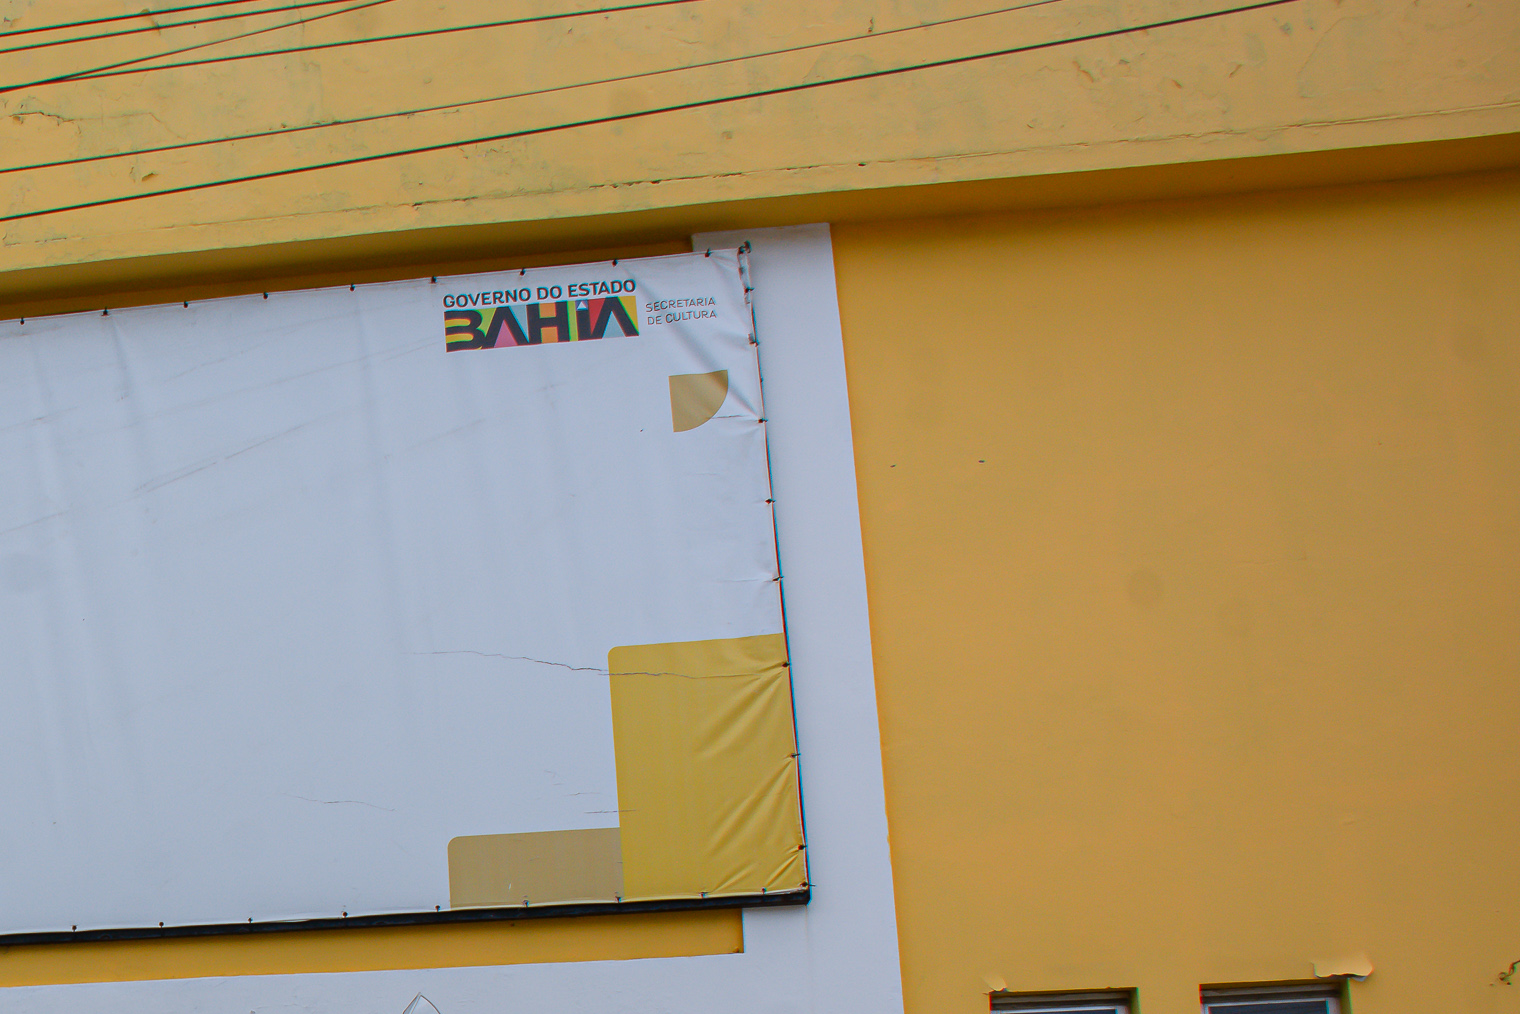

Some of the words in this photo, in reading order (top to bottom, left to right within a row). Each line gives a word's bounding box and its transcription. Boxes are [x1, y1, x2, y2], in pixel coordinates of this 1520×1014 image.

[443, 288, 531, 308] GOVERNO
[536, 286, 563, 300] DO
[568, 279, 636, 297] ESTADO
[645, 297, 716, 313] SECRETARIA
[647, 314, 663, 326] DE
[665, 310, 718, 324] CULTURA
